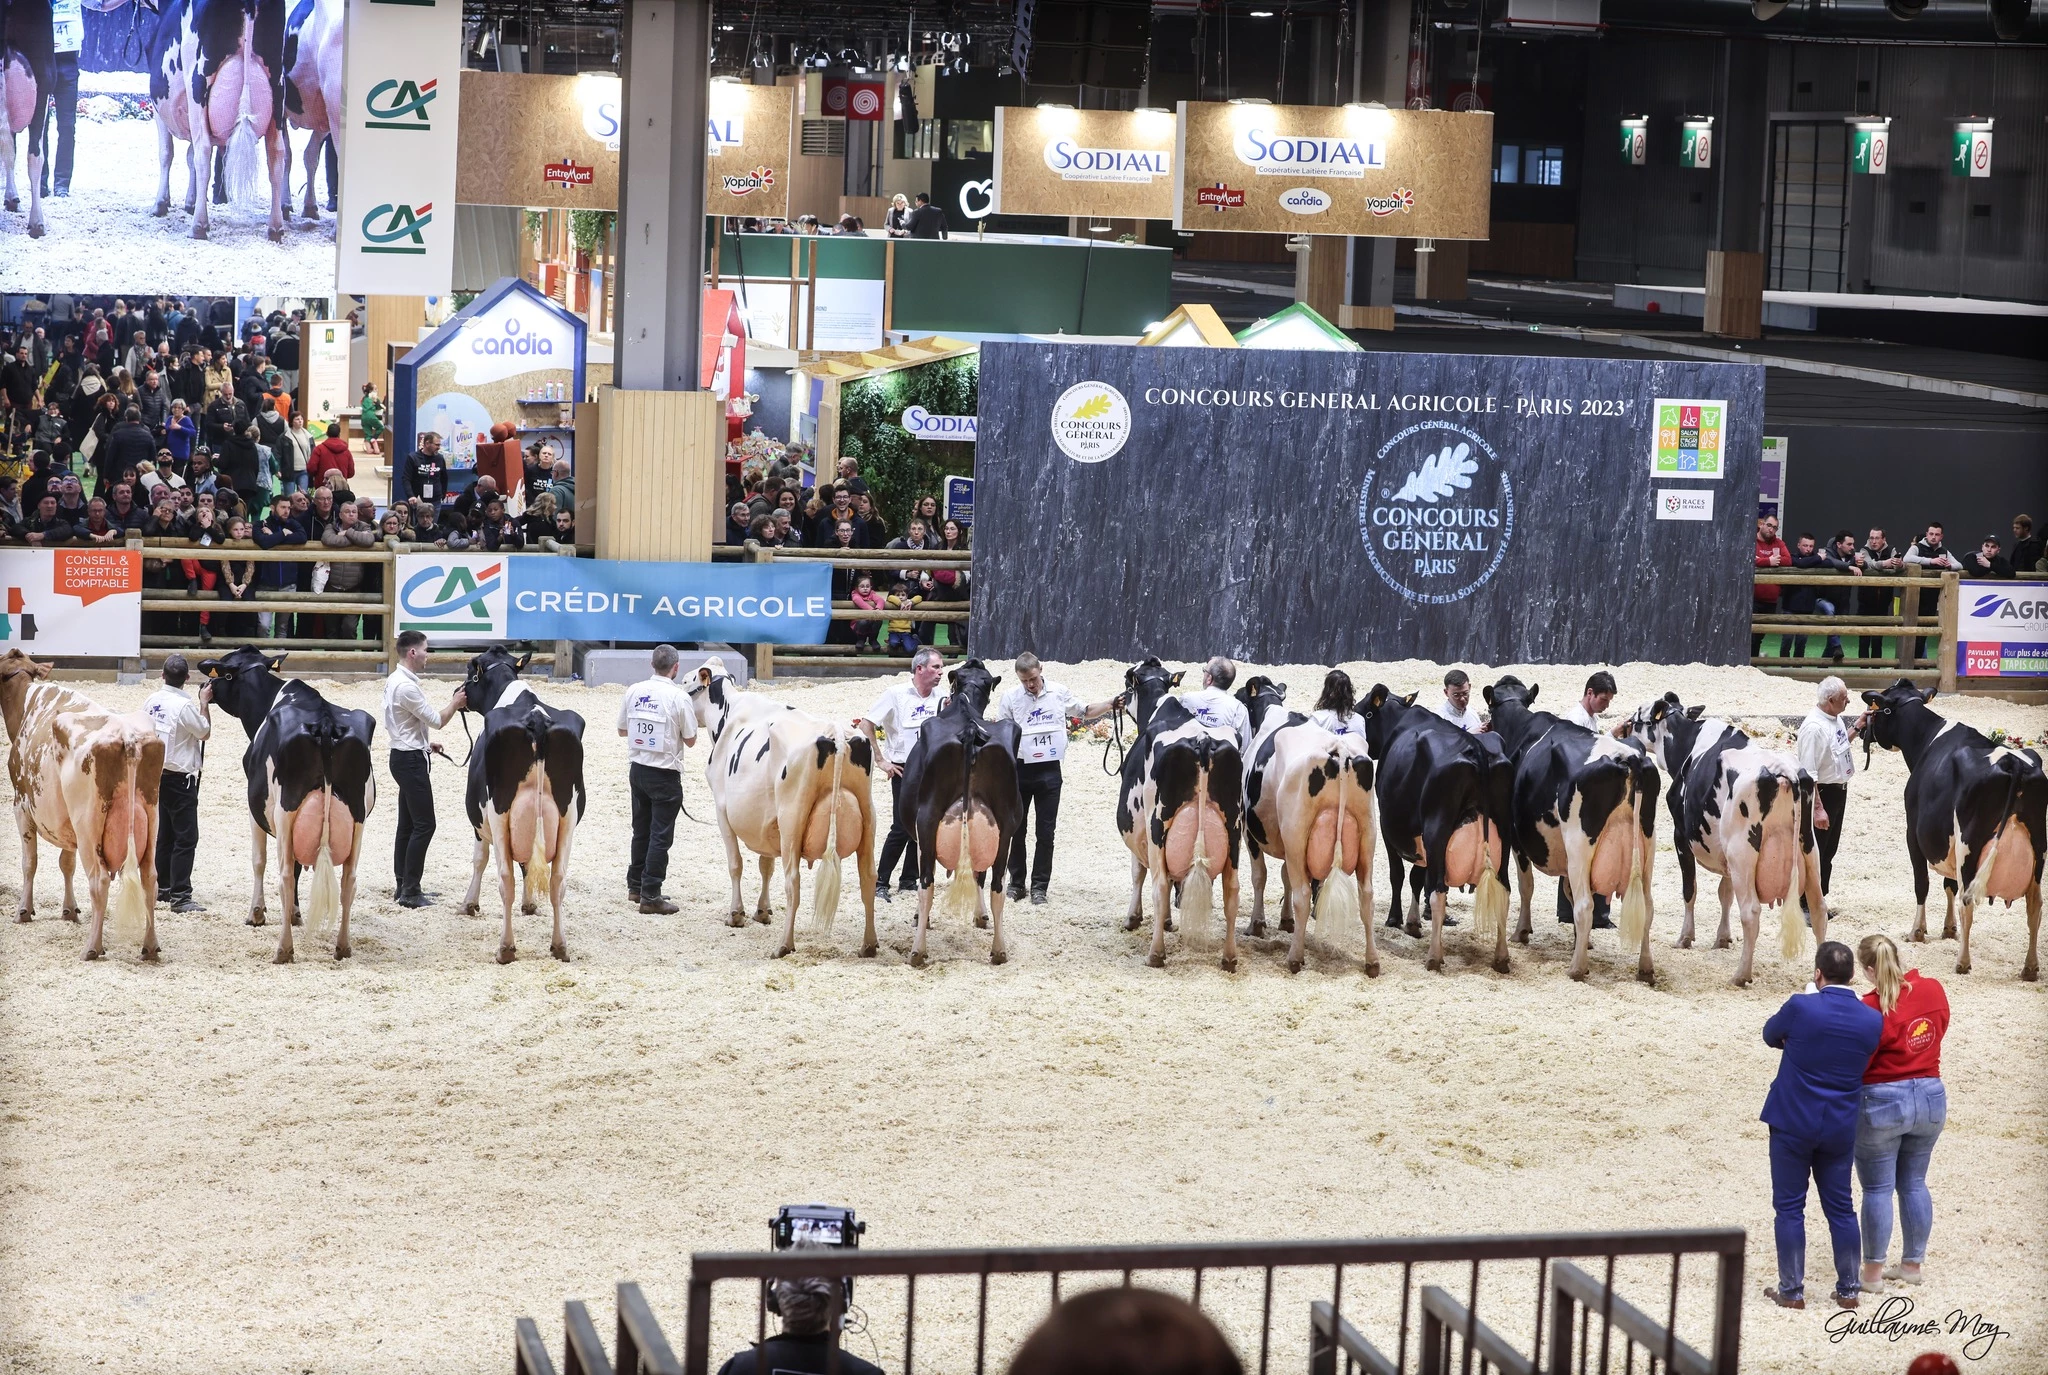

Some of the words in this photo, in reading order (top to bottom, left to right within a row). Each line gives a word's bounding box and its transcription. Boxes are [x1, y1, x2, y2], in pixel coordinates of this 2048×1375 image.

[1258, 166, 1301, 175] Coopérative
[1301, 167, 1328, 175] Laitière
[1328, 168, 1362, 176] Française
[1064, 172, 1100, 181] Coopérative
[1122, 173, 1151, 182] Française
[1287, 196, 1323, 207] candia
[471, 332, 553, 356] candia
[1144, 387, 1274, 410] CONCOURS
[1280, 390, 1382, 411] GENERAL
[1386, 393, 1497, 414] AGRICOLE
[1517, 389, 1573, 419] PARIS
[1580, 399, 1626, 418] 2023
[1060, 421, 1122, 430] CONCOURS
[1065, 429, 1116, 440] GÉNÉRAL
[1080, 440, 1101, 450] PARIS
[1376, 423, 1420, 460] CONCOURS
[1420, 420, 1460, 433] GÉNÉRAL
[1458, 427, 1498, 461] AGRICOLE
[1358, 468, 1376, 526] MINISTÈRE
[1682, 498, 1706, 506] RACES
[1372, 506, 1500, 528] CONCOURS
[1360, 527, 1371, 542] DE
[1382, 526, 1489, 551] GÉNÉRAL
[65, 555, 117, 566] CONSEIL
[119, 555, 129, 566] &
[1414, 552, 1457, 578] PARIS
[65, 567, 129, 577] EXPERTISE
[1363, 541, 1419, 601] L'AGRICULTURE
[1457, 539, 1509, 600] SOUVERAINETÉ
[65, 578, 129, 589] COMPTABLE
[515, 585, 642, 615] CRÉDIT
[652, 595, 826, 618] AGRICOLE
[1417, 593, 1430, 604] ET
[1431, 594, 1445, 605] DE
[1444, 592, 1458, 604] LA
[1968, 648, 1995, 656] PAVILLON
[1995, 649, 1999, 657] 1
[2004, 648, 2016, 657] Pour
[2017, 648, 2031, 659] plus
[2031, 648, 2040, 657] de
[1968, 658, 1976, 669] P
[1977, 658, 1999, 670] 026
[2005, 659, 2027, 670] TAPIS
[647, 702, 659, 710] PHF
[637, 722, 654, 735] 139
[1032, 734, 1053, 747] 141
